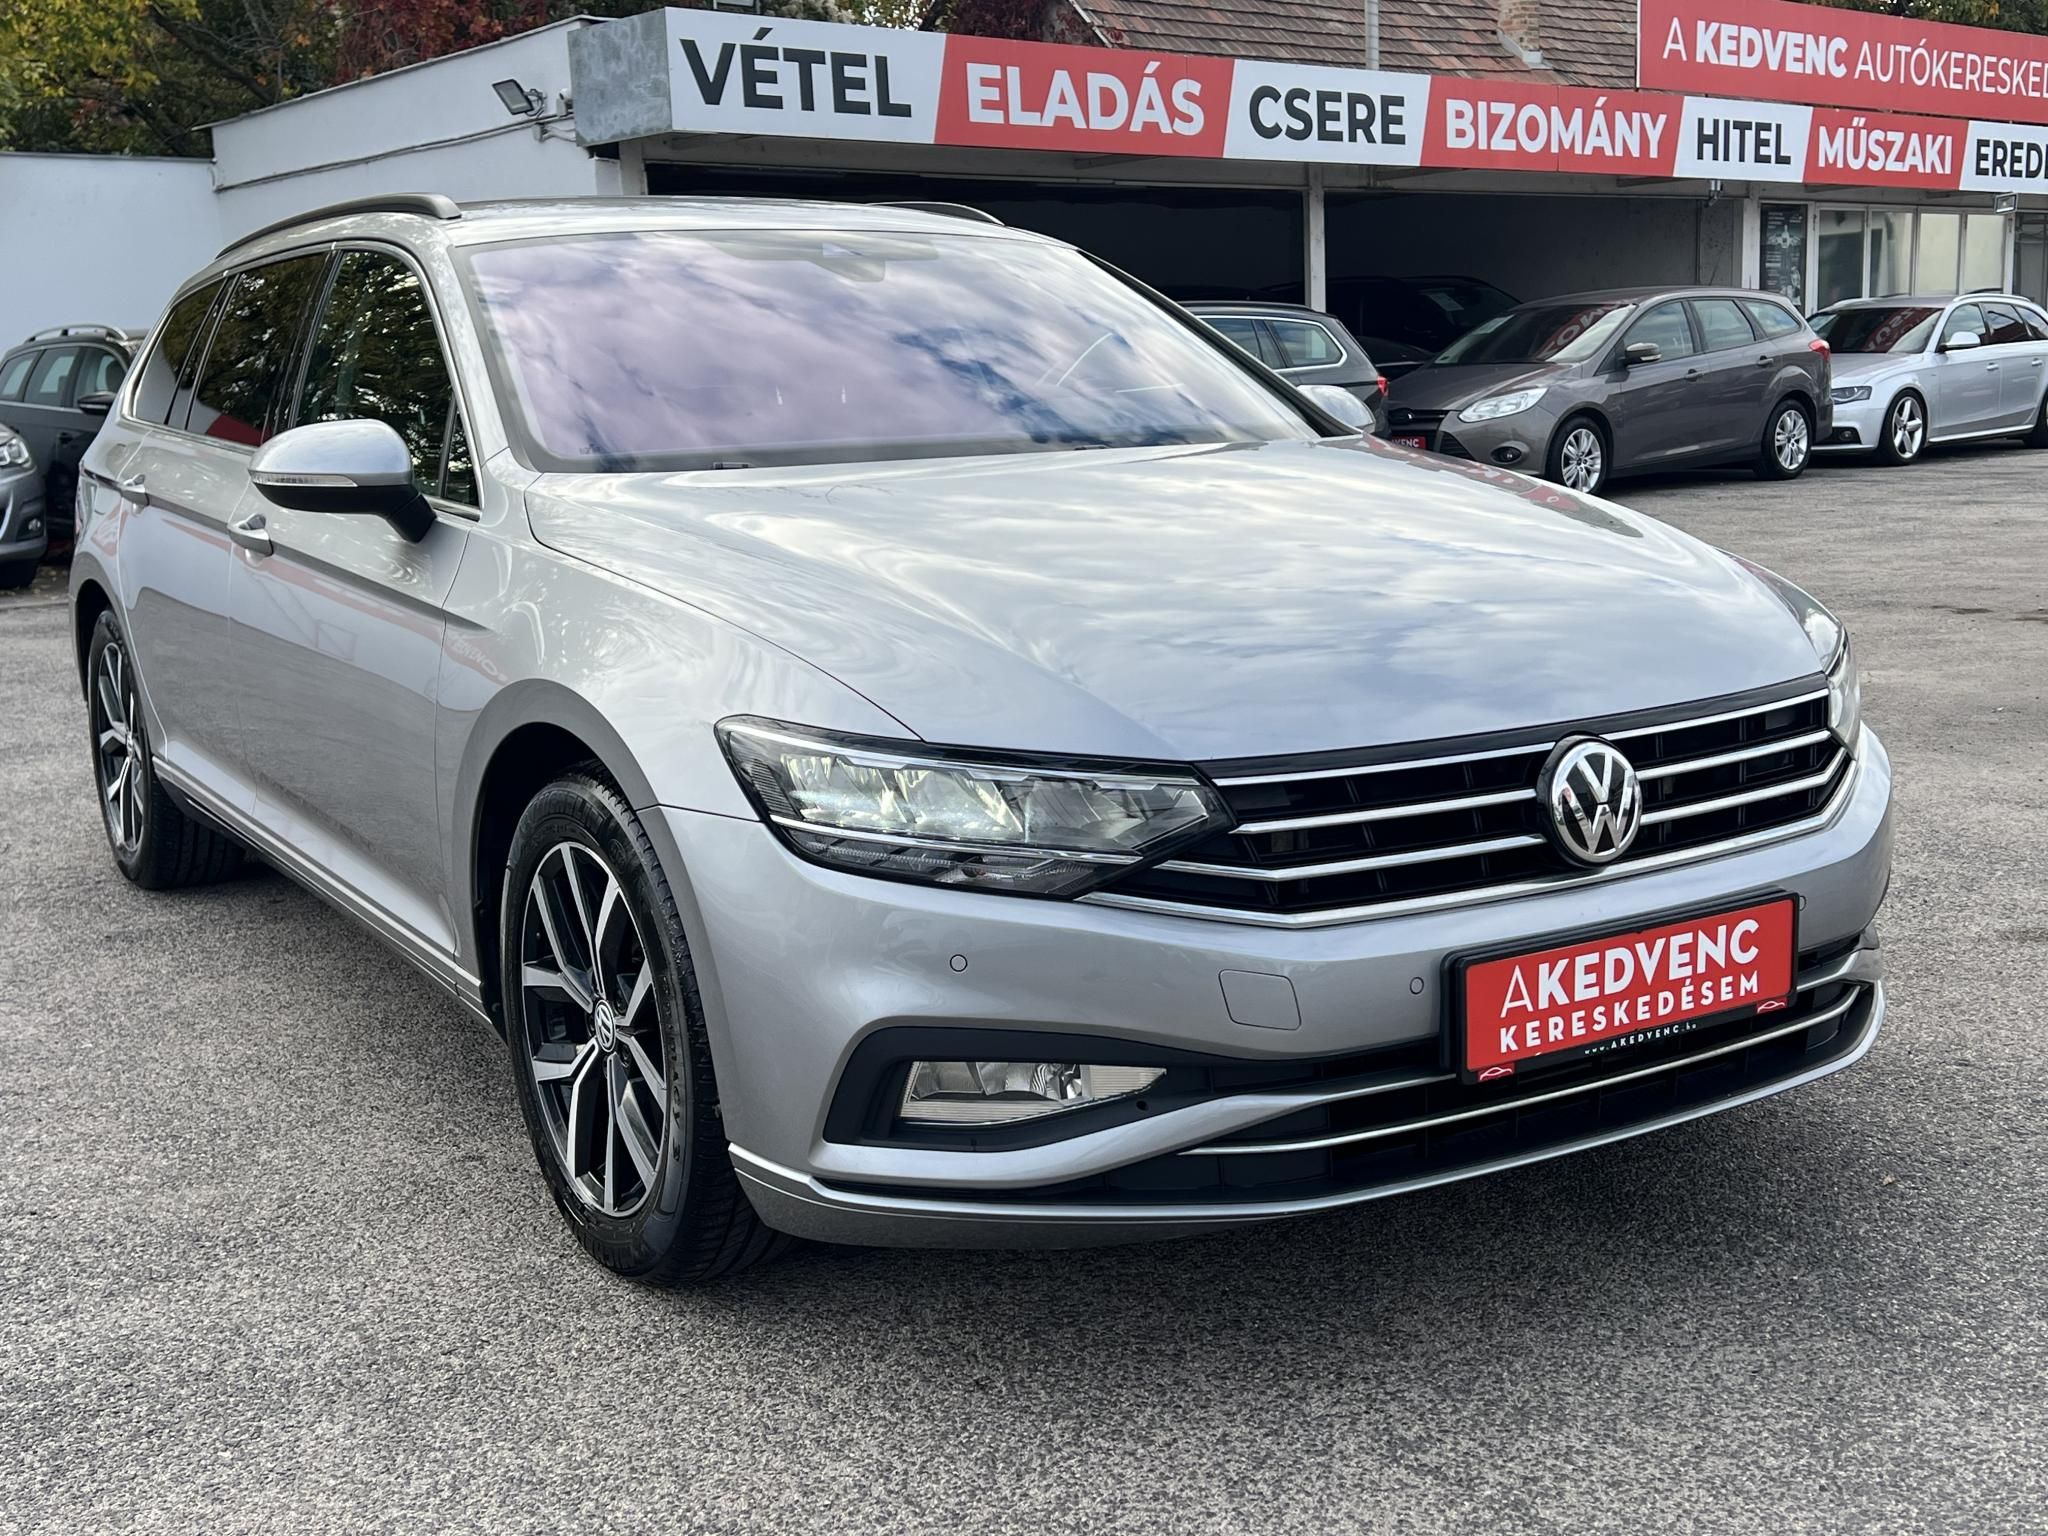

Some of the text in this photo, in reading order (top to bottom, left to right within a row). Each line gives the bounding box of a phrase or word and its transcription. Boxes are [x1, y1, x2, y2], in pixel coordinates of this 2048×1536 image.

[1662, 16, 1688, 62] A
[1696, 20, 1849, 78] KEDVENC
[679, 27, 912, 118] VÉTEL
[966, 61, 1205, 136] ELADÁS
[1249, 85, 1406, 145] CSERE
[1445, 96, 1668, 159] BIZOMÁNY
[1696, 117, 1792, 165] HITEL
[1818, 117, 1953, 174] MŰSZAKI
[1500, 970, 1758, 1053] KERESKEDÉSEM
